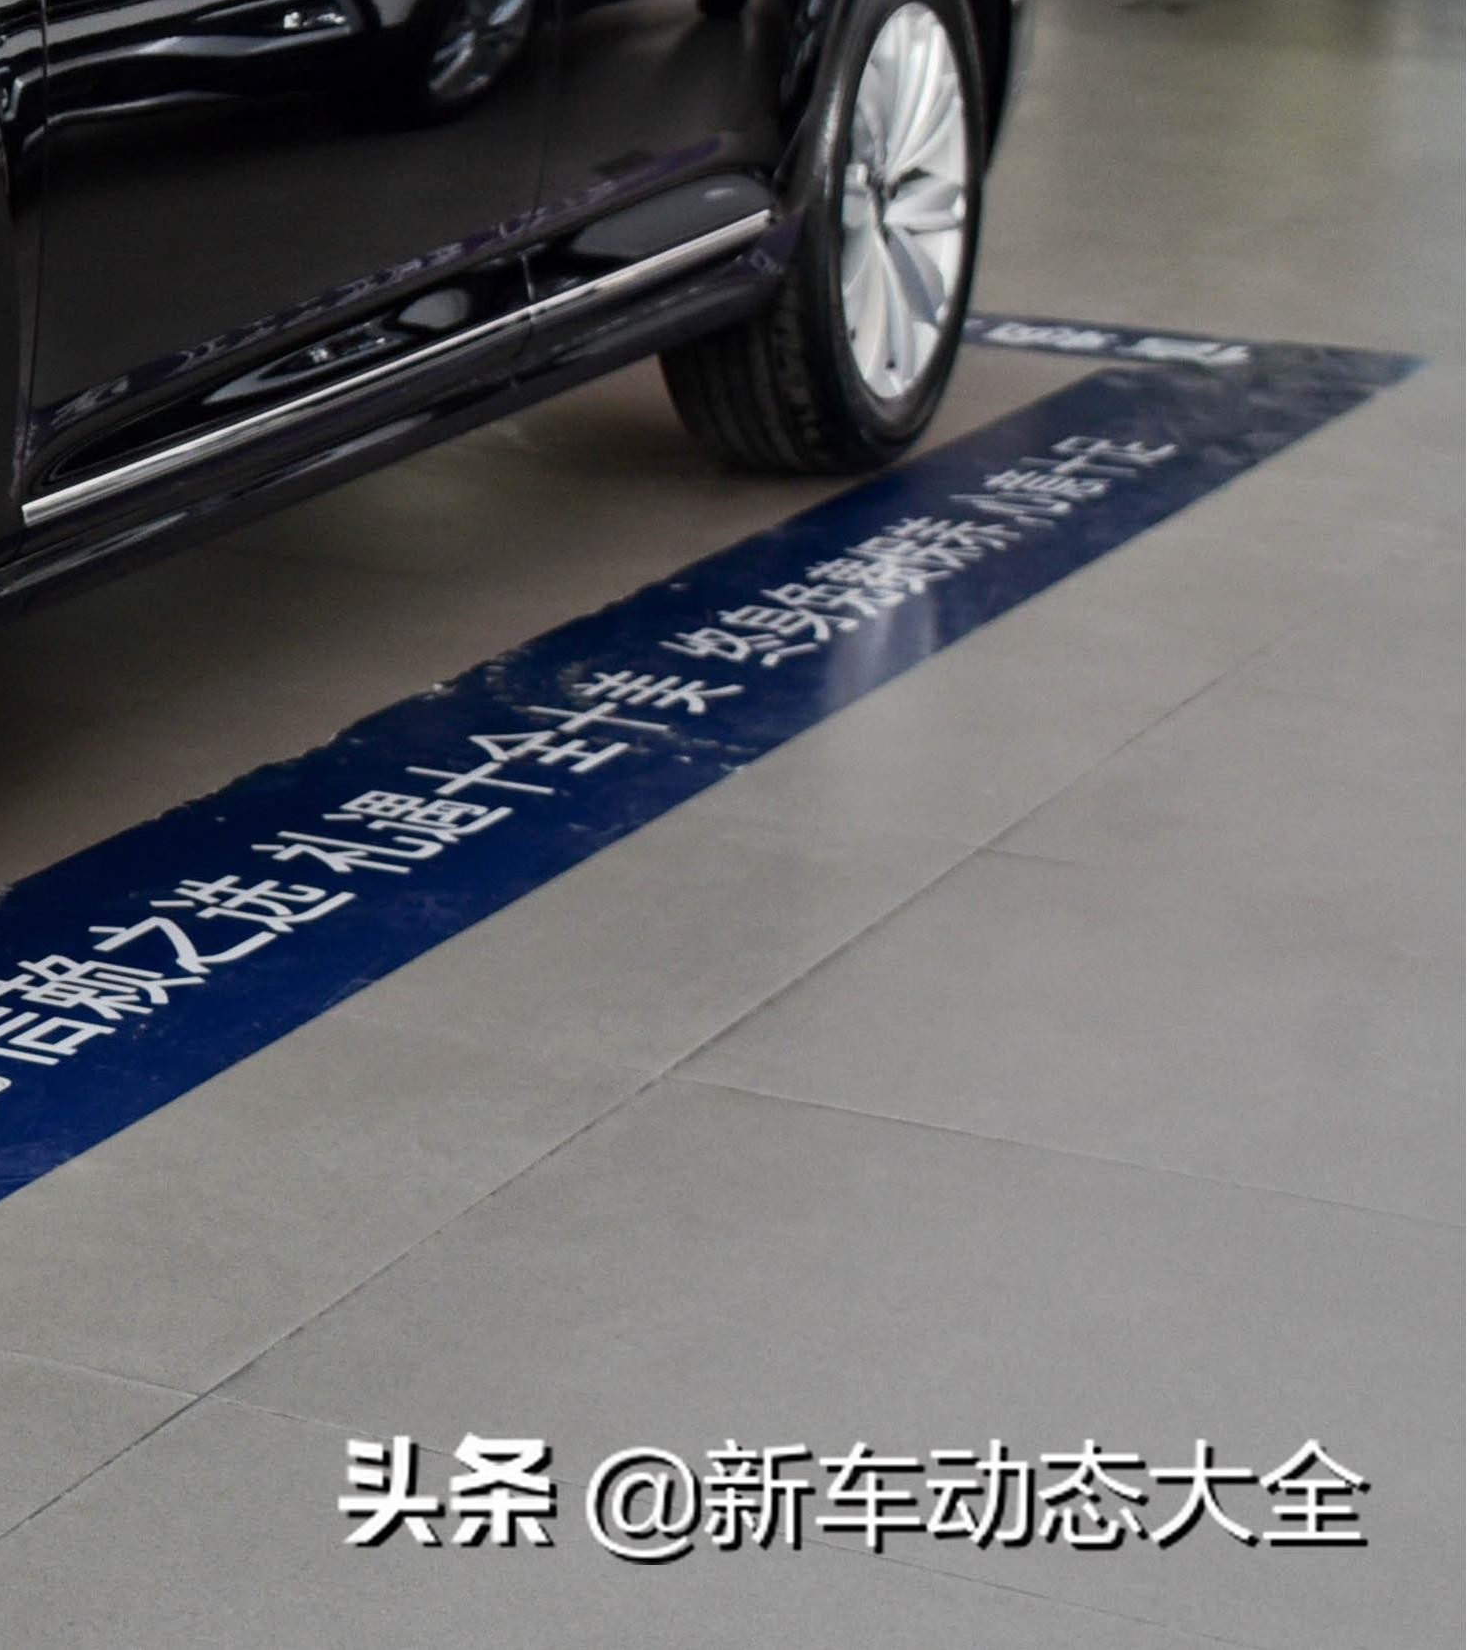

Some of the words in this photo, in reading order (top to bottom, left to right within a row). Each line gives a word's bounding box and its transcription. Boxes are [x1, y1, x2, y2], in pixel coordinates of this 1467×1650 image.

[251, 670, 744, 875] 礼遇十全十美
